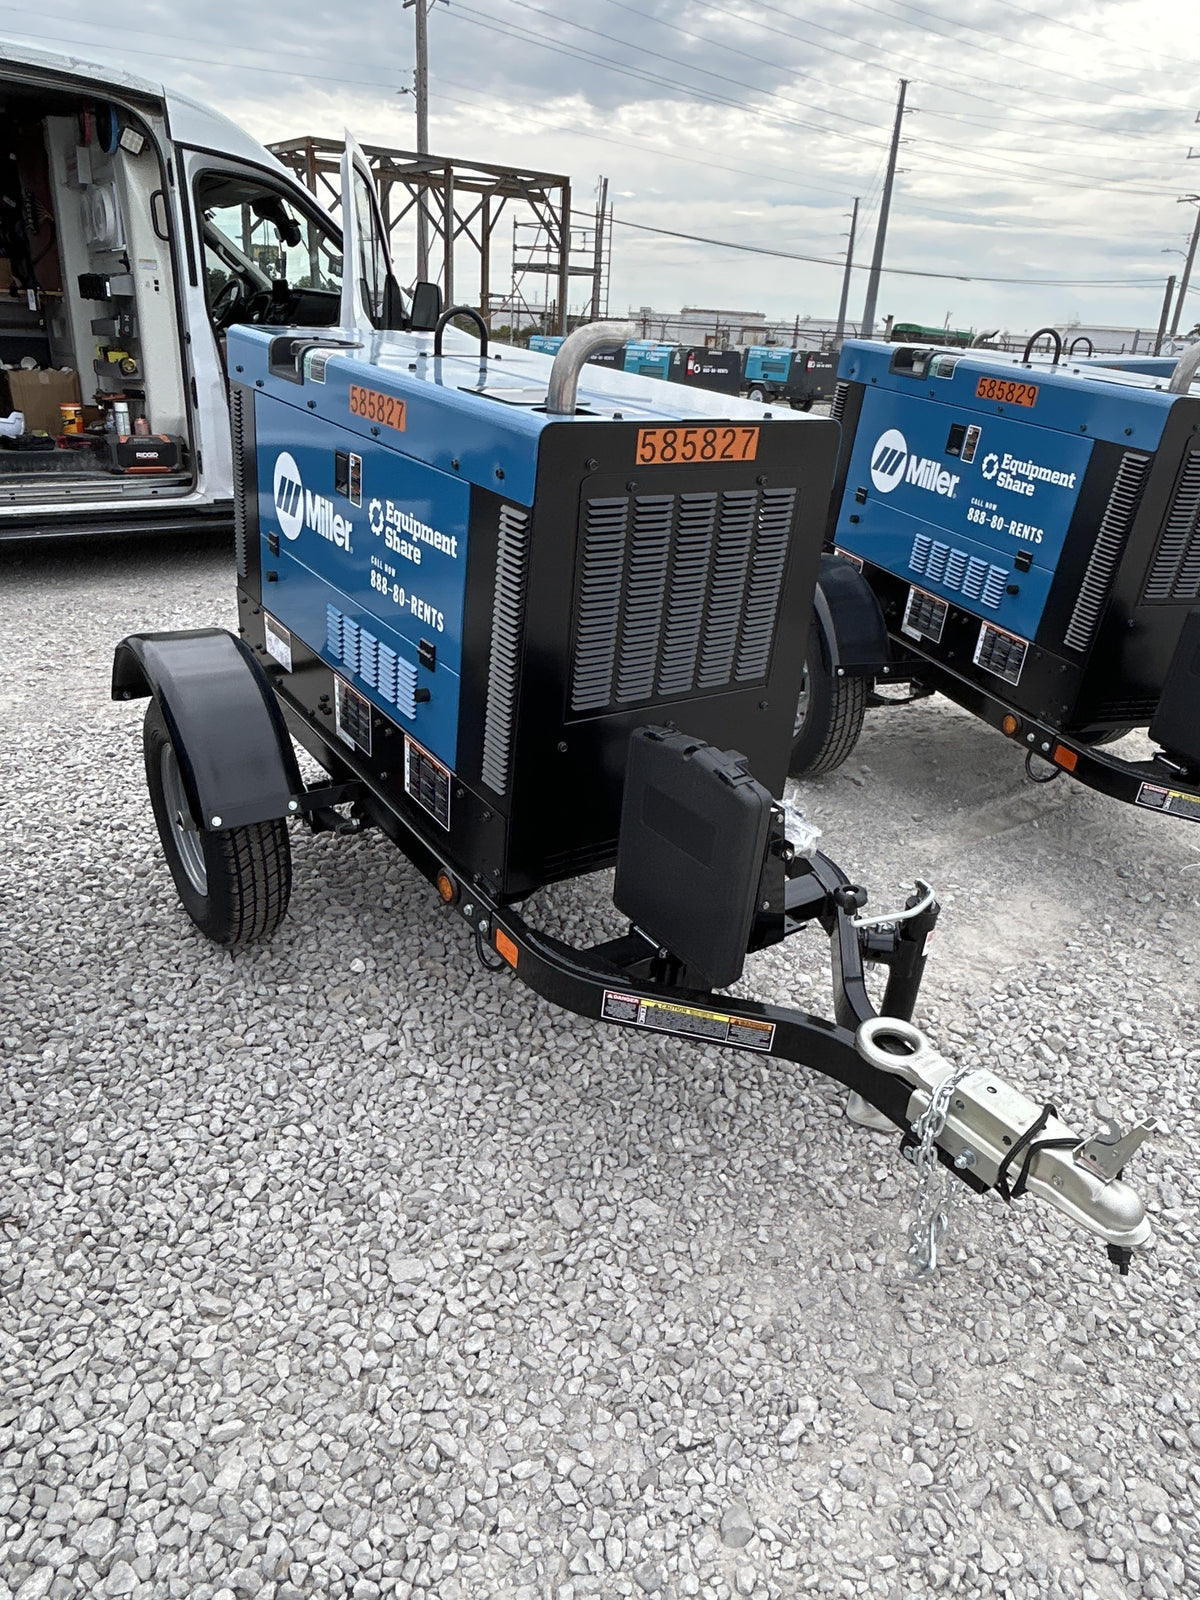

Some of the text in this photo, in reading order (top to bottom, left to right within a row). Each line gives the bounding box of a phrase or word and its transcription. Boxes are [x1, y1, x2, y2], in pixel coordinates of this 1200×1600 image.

[350, 386, 405, 429] 585827
[977, 378, 1037, 406] 585829
[640, 429, 755, 462] 585827
[905, 454, 960, 498] Miller
[996, 471, 1035, 497] Share
[1001, 453, 1077, 489] Equipment
[306, 489, 353, 551] Miller
[971, 497, 998, 511] CALL NOW
[385, 500, 458, 559] Equipment
[967, 507, 1044, 545] 888-80-RENTS
[385, 526, 421, 565] Share
[370, 555, 396, 578] CALL NOW
[370, 569, 444, 633] 888-80-RENTS
[613, 994, 639, 1004] DANGER
